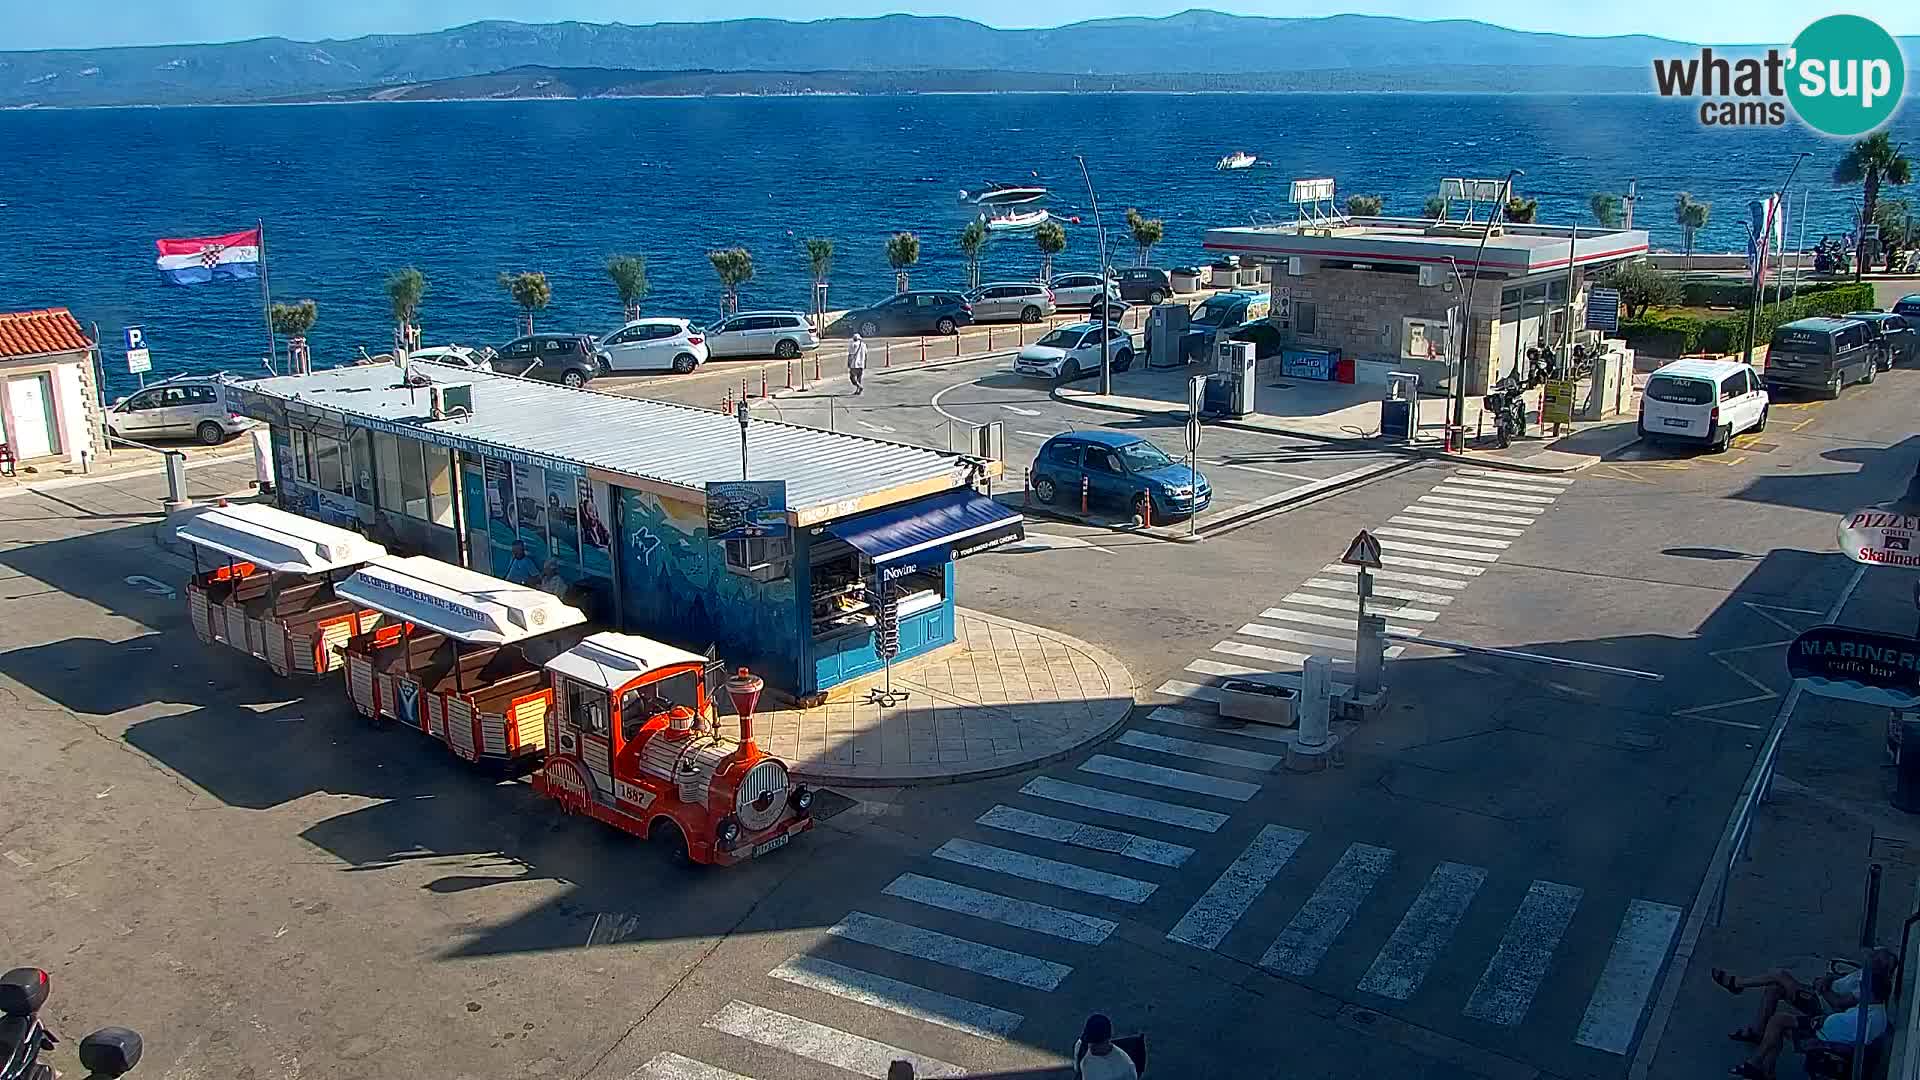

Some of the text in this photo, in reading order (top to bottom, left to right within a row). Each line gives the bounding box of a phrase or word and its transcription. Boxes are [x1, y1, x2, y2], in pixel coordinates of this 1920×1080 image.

[130, 329, 142, 348] P
[1793, 332, 1810, 340] TAXI
[436, 434, 467, 449] POSTAJA
[478, 445, 493, 457] BUS
[494, 448, 526, 463] STATION
[526, 455, 554, 469] TICKET
[555, 460, 582, 475] OFFICE
[1848, 514, 1920, 531] PIZZE
[449, 603, 461, 615] BOL
[461, 606, 485, 622] CENTER
[1870, 663, 1896, 677] bar
[623, 784, 645, 804] 1887
